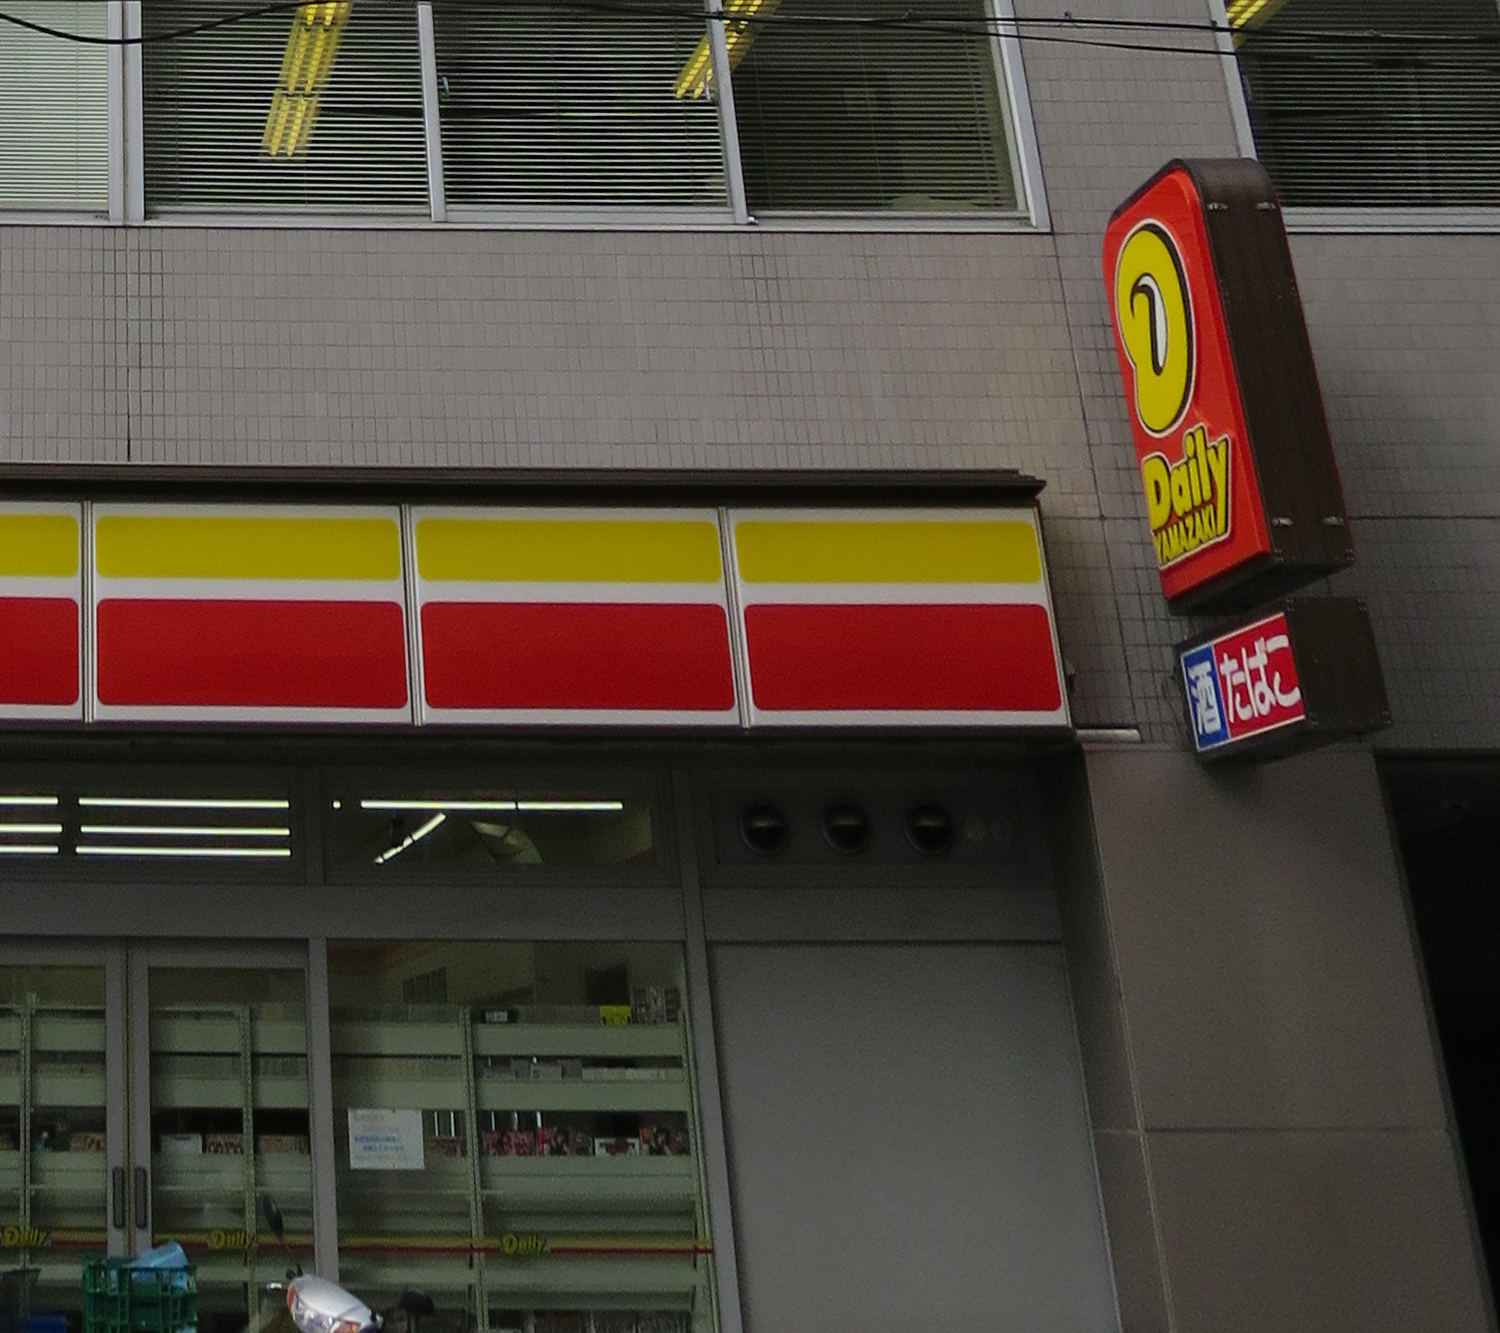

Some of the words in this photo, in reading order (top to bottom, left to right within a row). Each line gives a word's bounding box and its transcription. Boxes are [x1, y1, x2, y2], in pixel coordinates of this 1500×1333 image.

[1141, 423, 1230, 537] Daily
[1153, 503, 1218, 565] YAMAZAKI
[1187, 662, 1220, 736] 酒
[1219, 634, 1300, 724] たばこ
[4, 1224, 48, 1248] Daily
[502, 1230, 545, 1254] Daily
